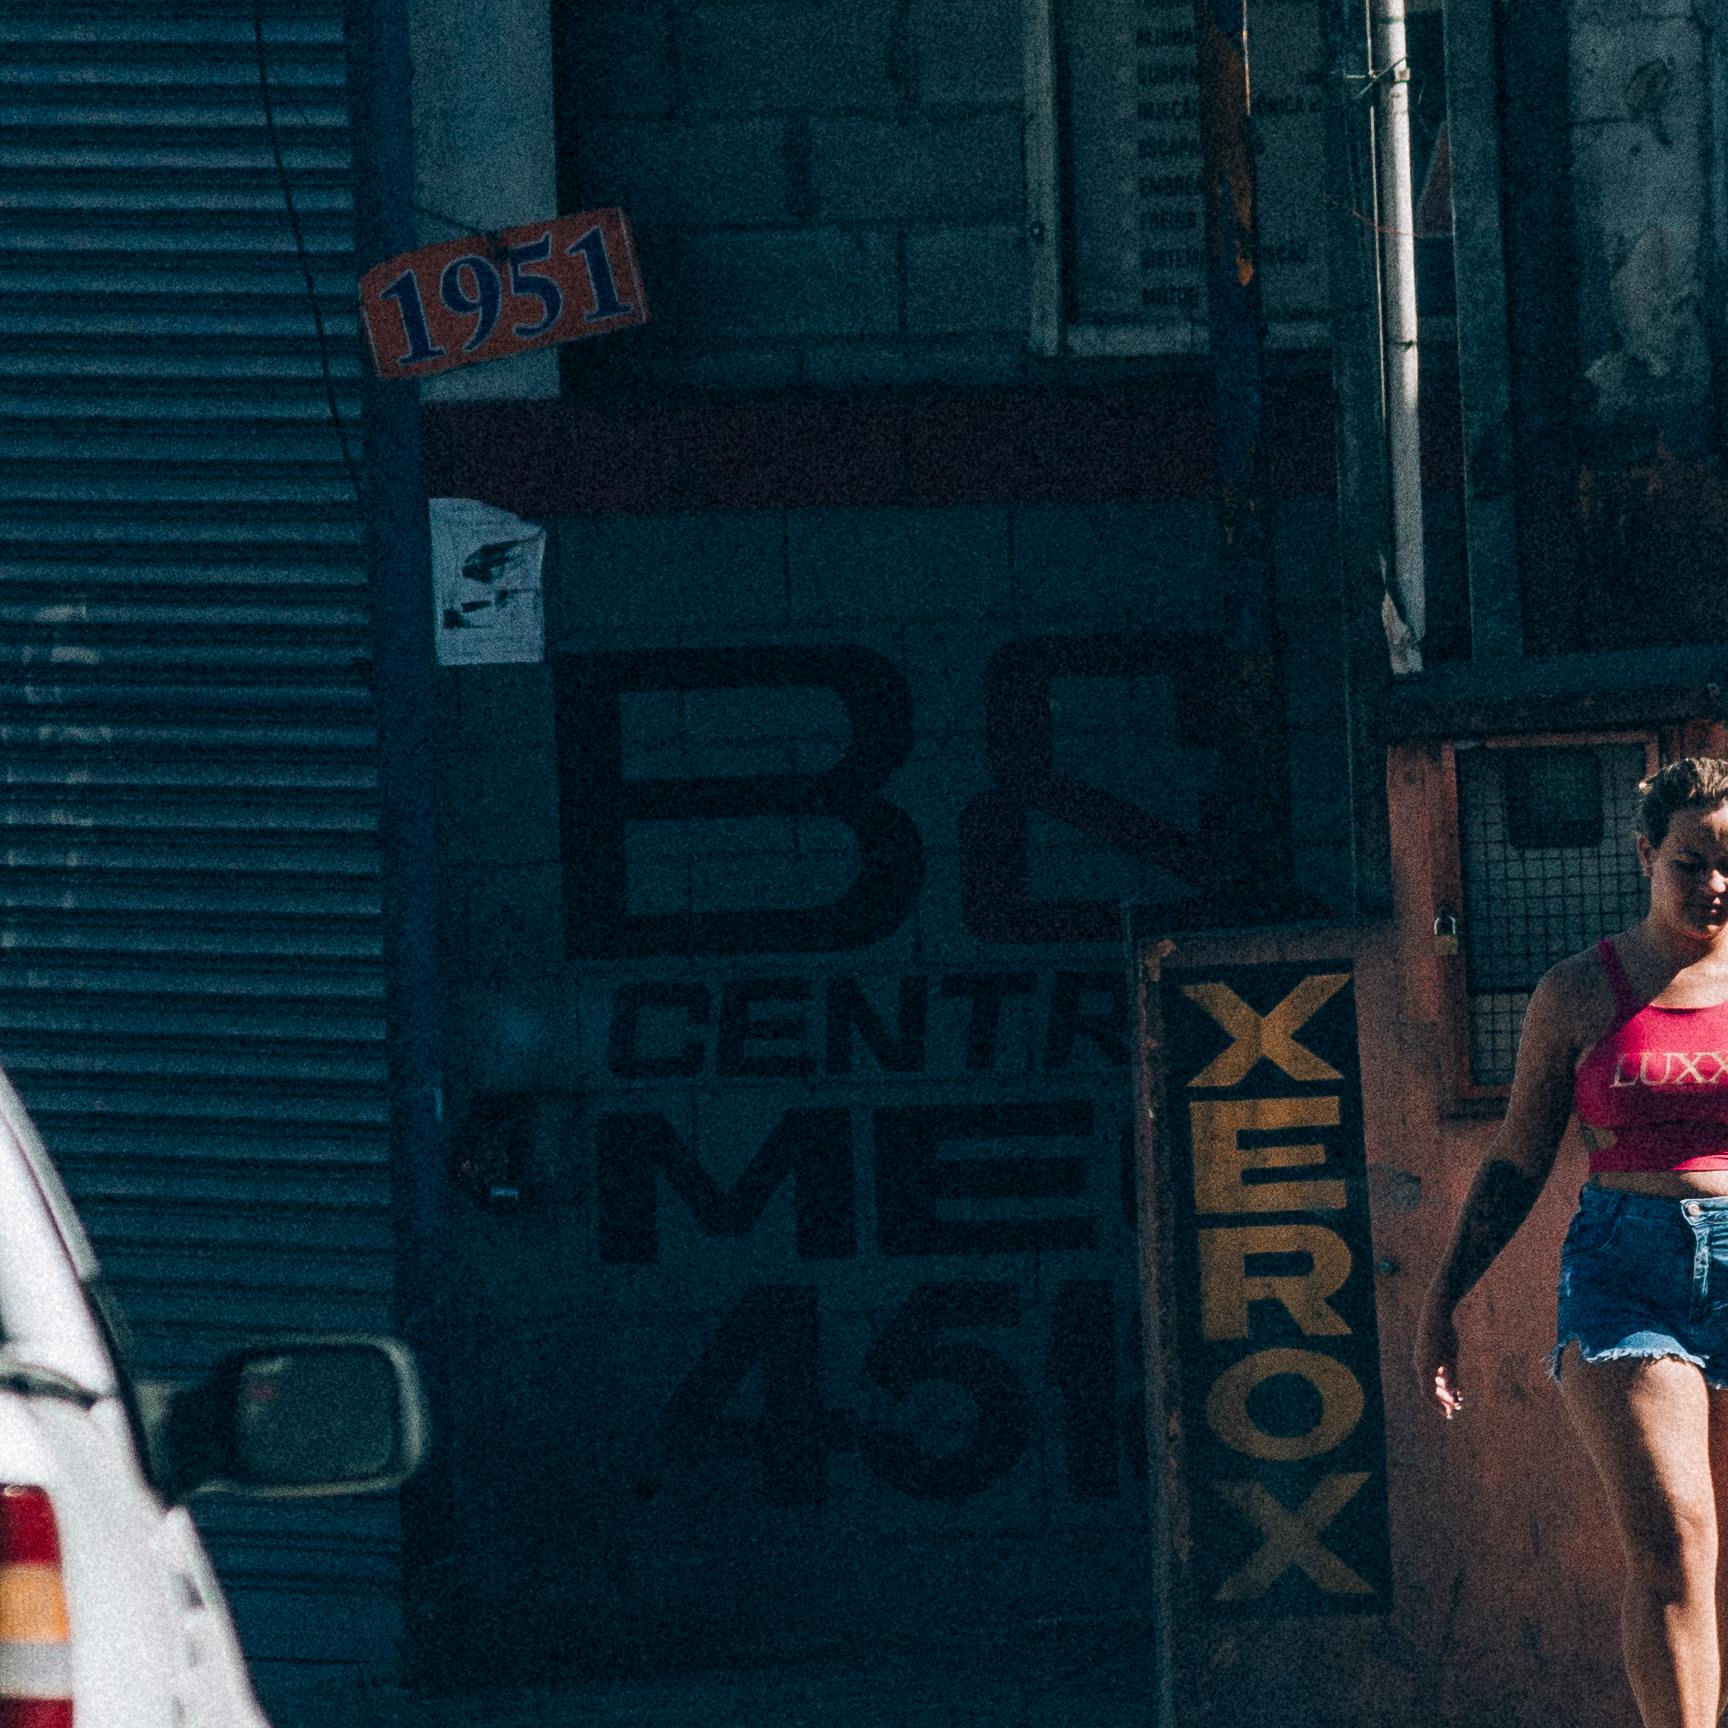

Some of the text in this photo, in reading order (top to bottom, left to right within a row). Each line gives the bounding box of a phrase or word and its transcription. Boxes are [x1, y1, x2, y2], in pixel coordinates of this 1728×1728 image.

[380, 225, 636, 368] 1951
[597, 1101, 1137, 1266] ME
[1177, 968, 1376, 1603] XEROX
